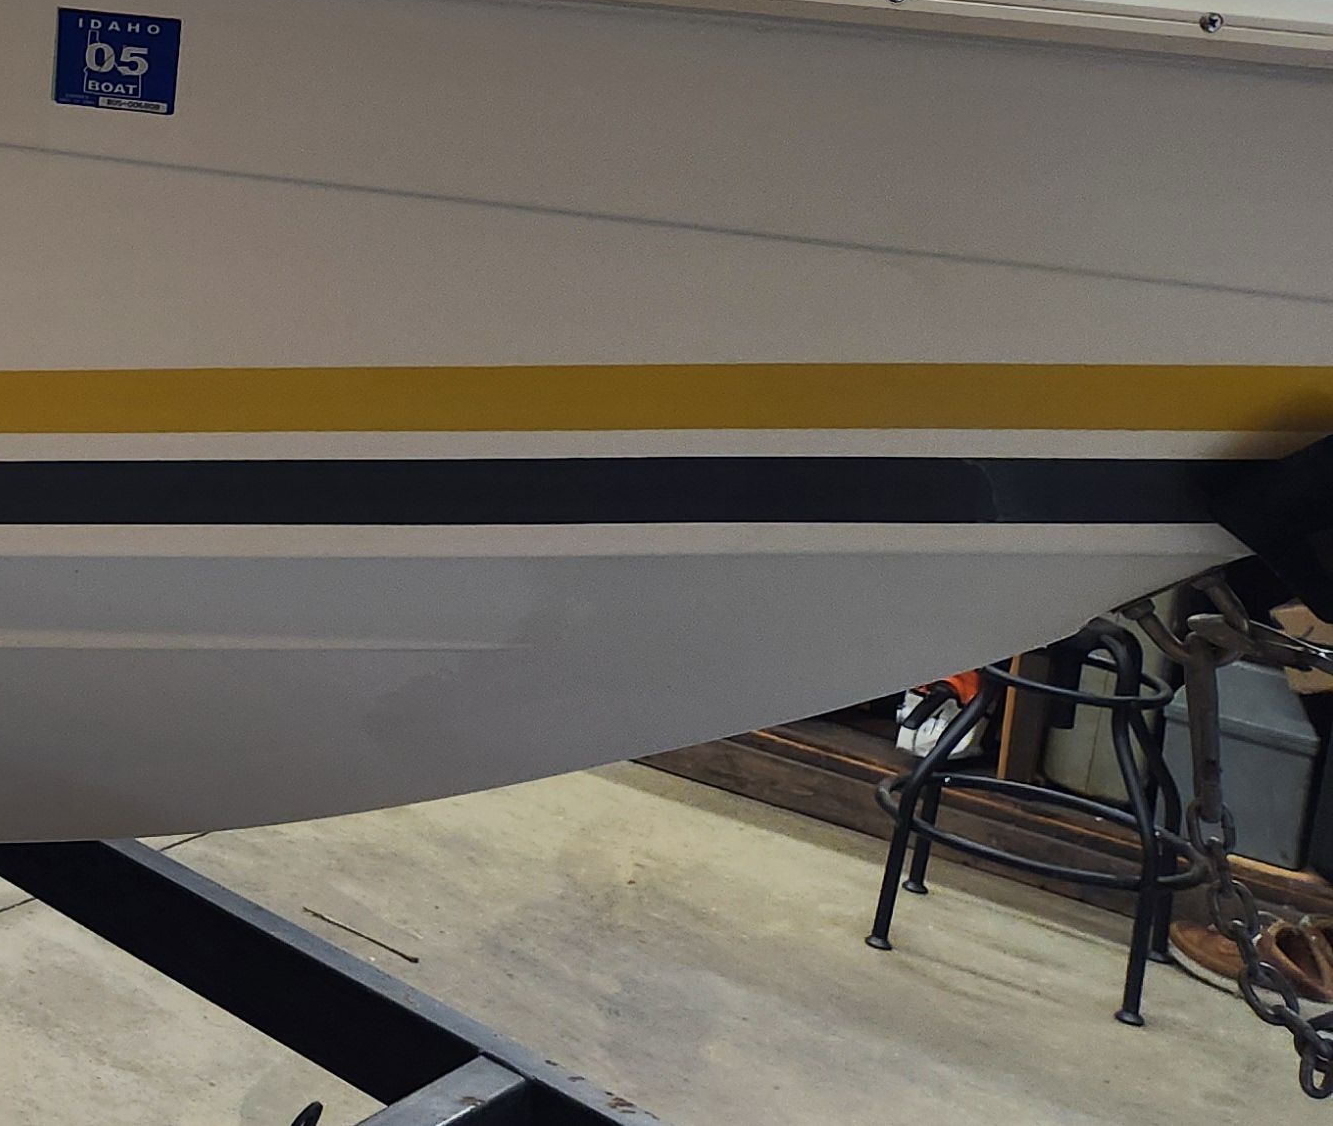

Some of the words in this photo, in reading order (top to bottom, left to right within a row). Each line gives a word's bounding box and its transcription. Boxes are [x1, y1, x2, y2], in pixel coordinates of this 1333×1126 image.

[78, 18, 160, 34] IDAHO
[85, 42, 149, 75] 05
[88, 80, 137, 94] BOAT
